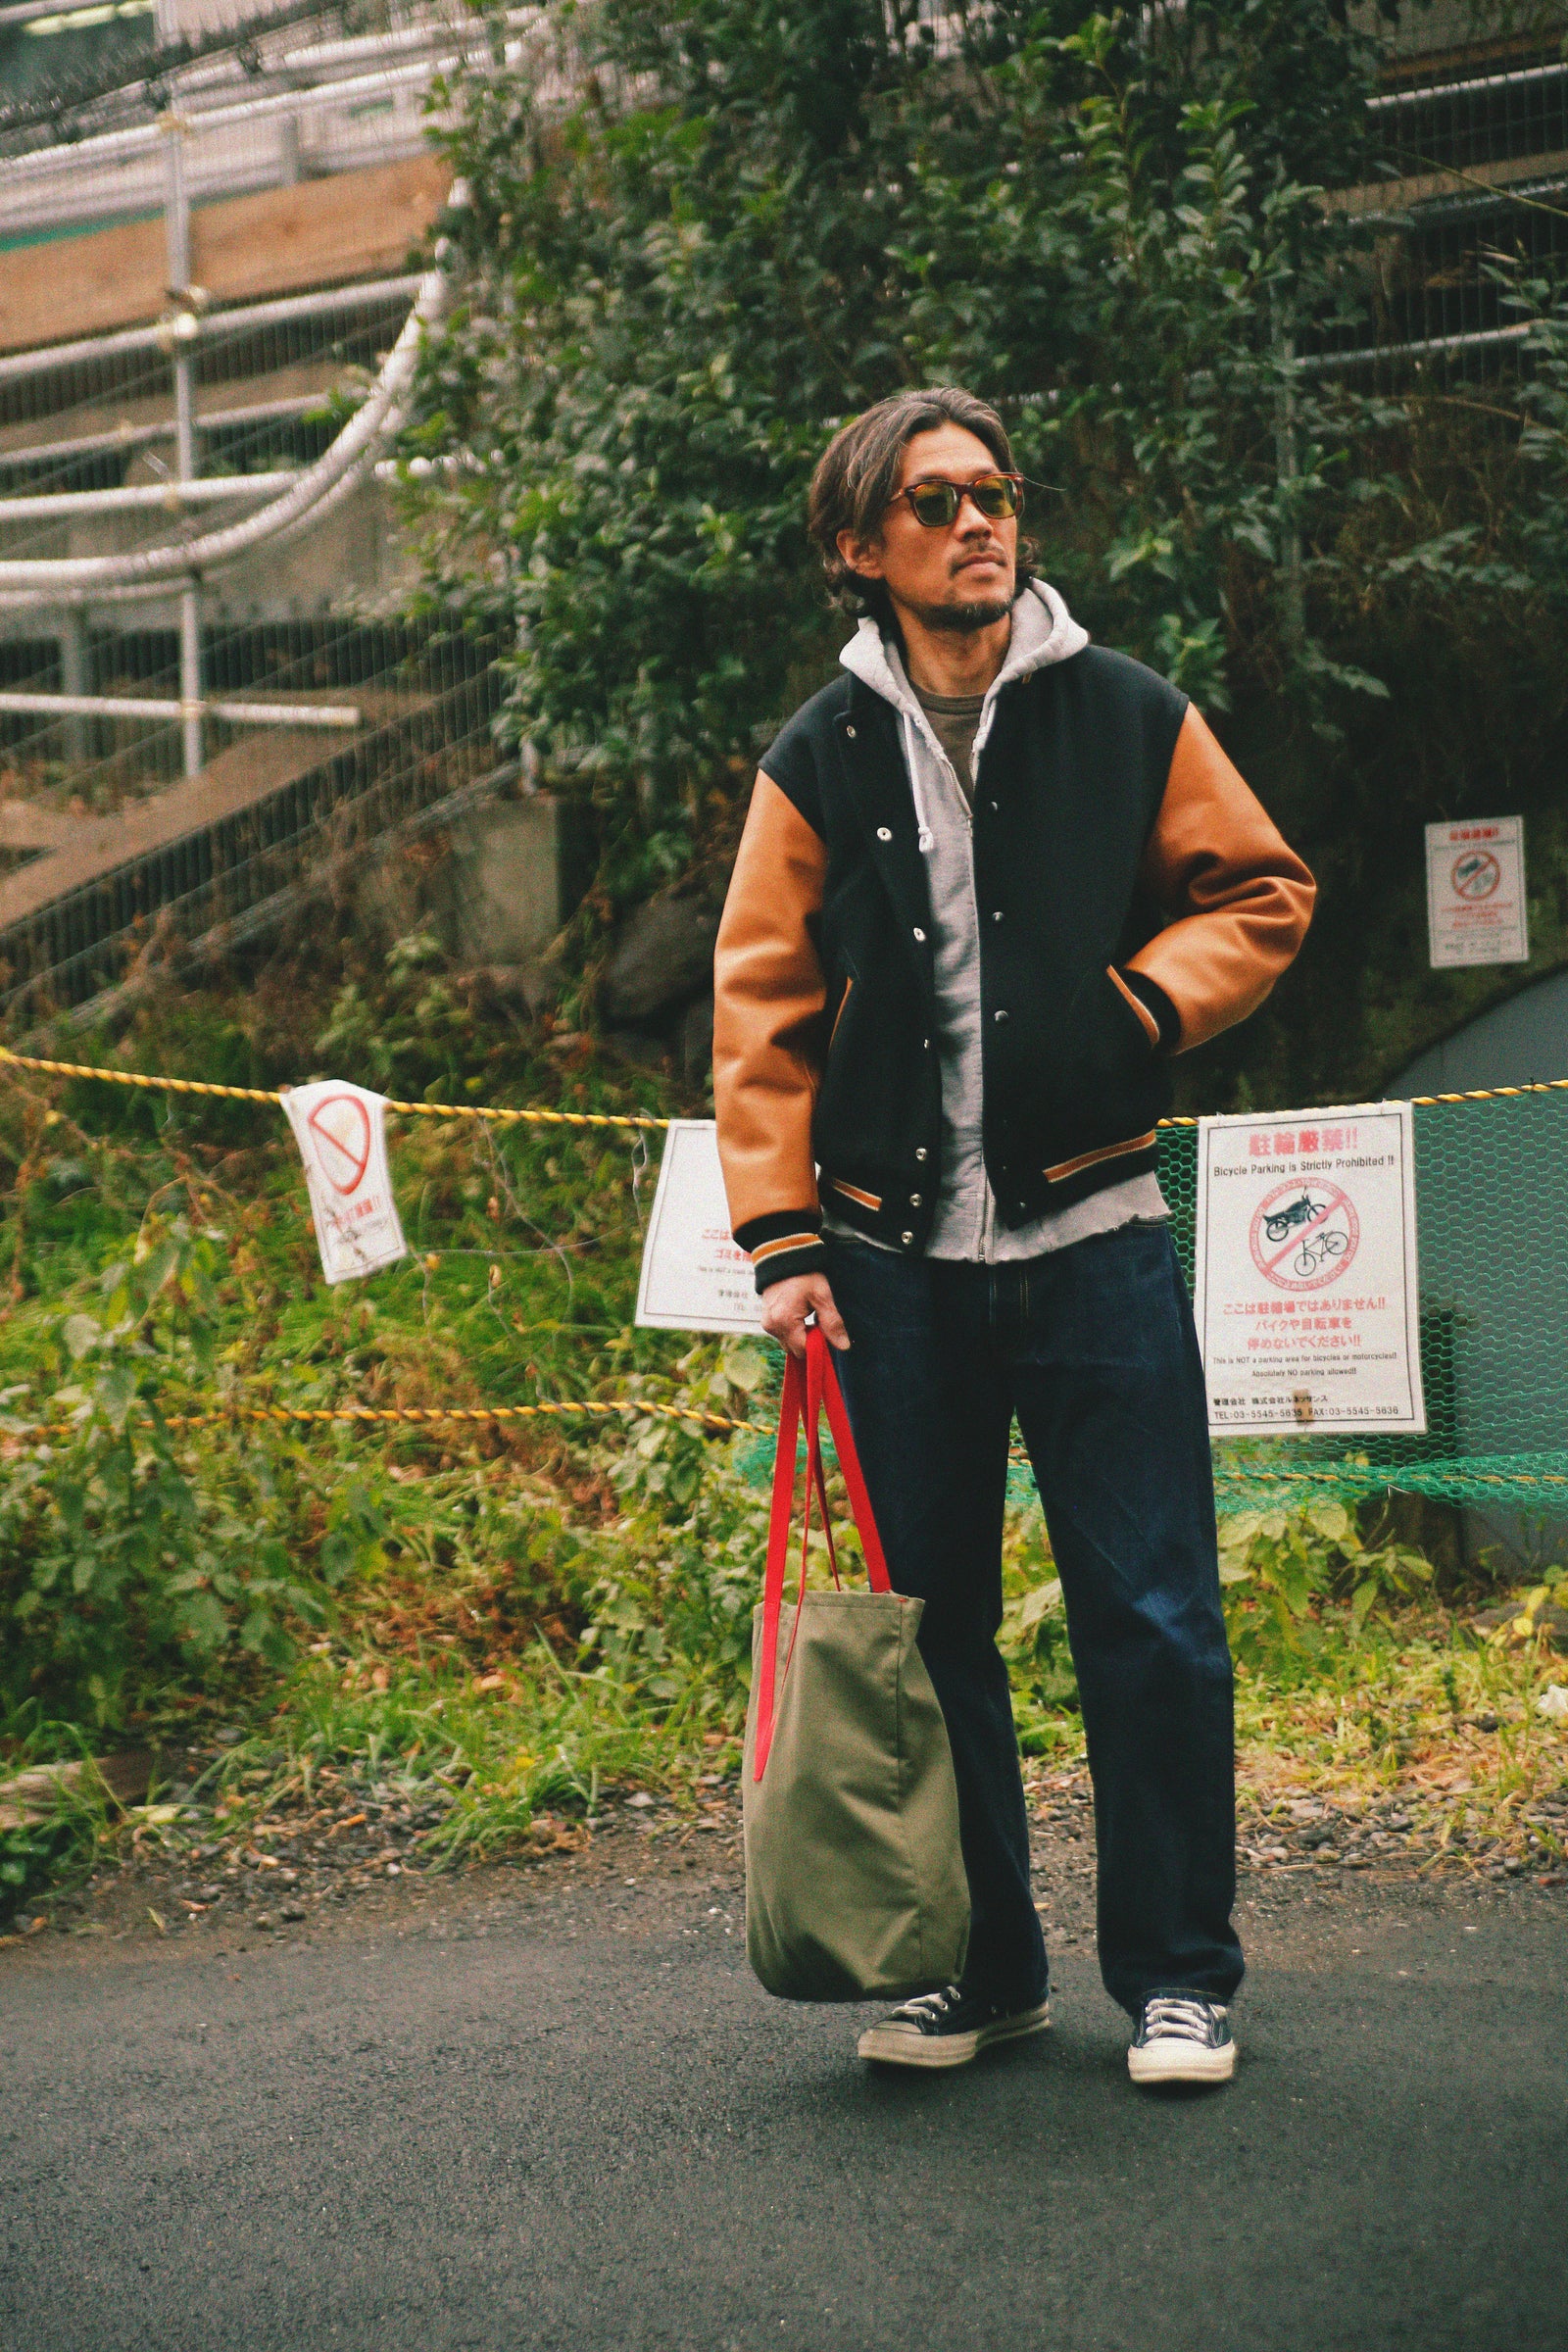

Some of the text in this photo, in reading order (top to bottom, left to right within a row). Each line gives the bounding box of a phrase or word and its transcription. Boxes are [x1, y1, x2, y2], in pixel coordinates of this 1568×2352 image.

[1213, 1165, 1248, 1177] Bicycle
[1250, 1162, 1286, 1174] Parking
[1289, 1162, 1297, 1172] is
[1300, 1159, 1333, 1171] Strictly
[1336, 1155, 1384, 1168] Prohibited
[1254, 1316, 1352, 1332] バイクや自転車を
[1236, 1355, 1250, 1364] NOT
[1312, 1352, 1341, 1362] bicycles
[1287, 1368, 1298, 1377] NO
[1299, 1368, 1325, 1378] parking
